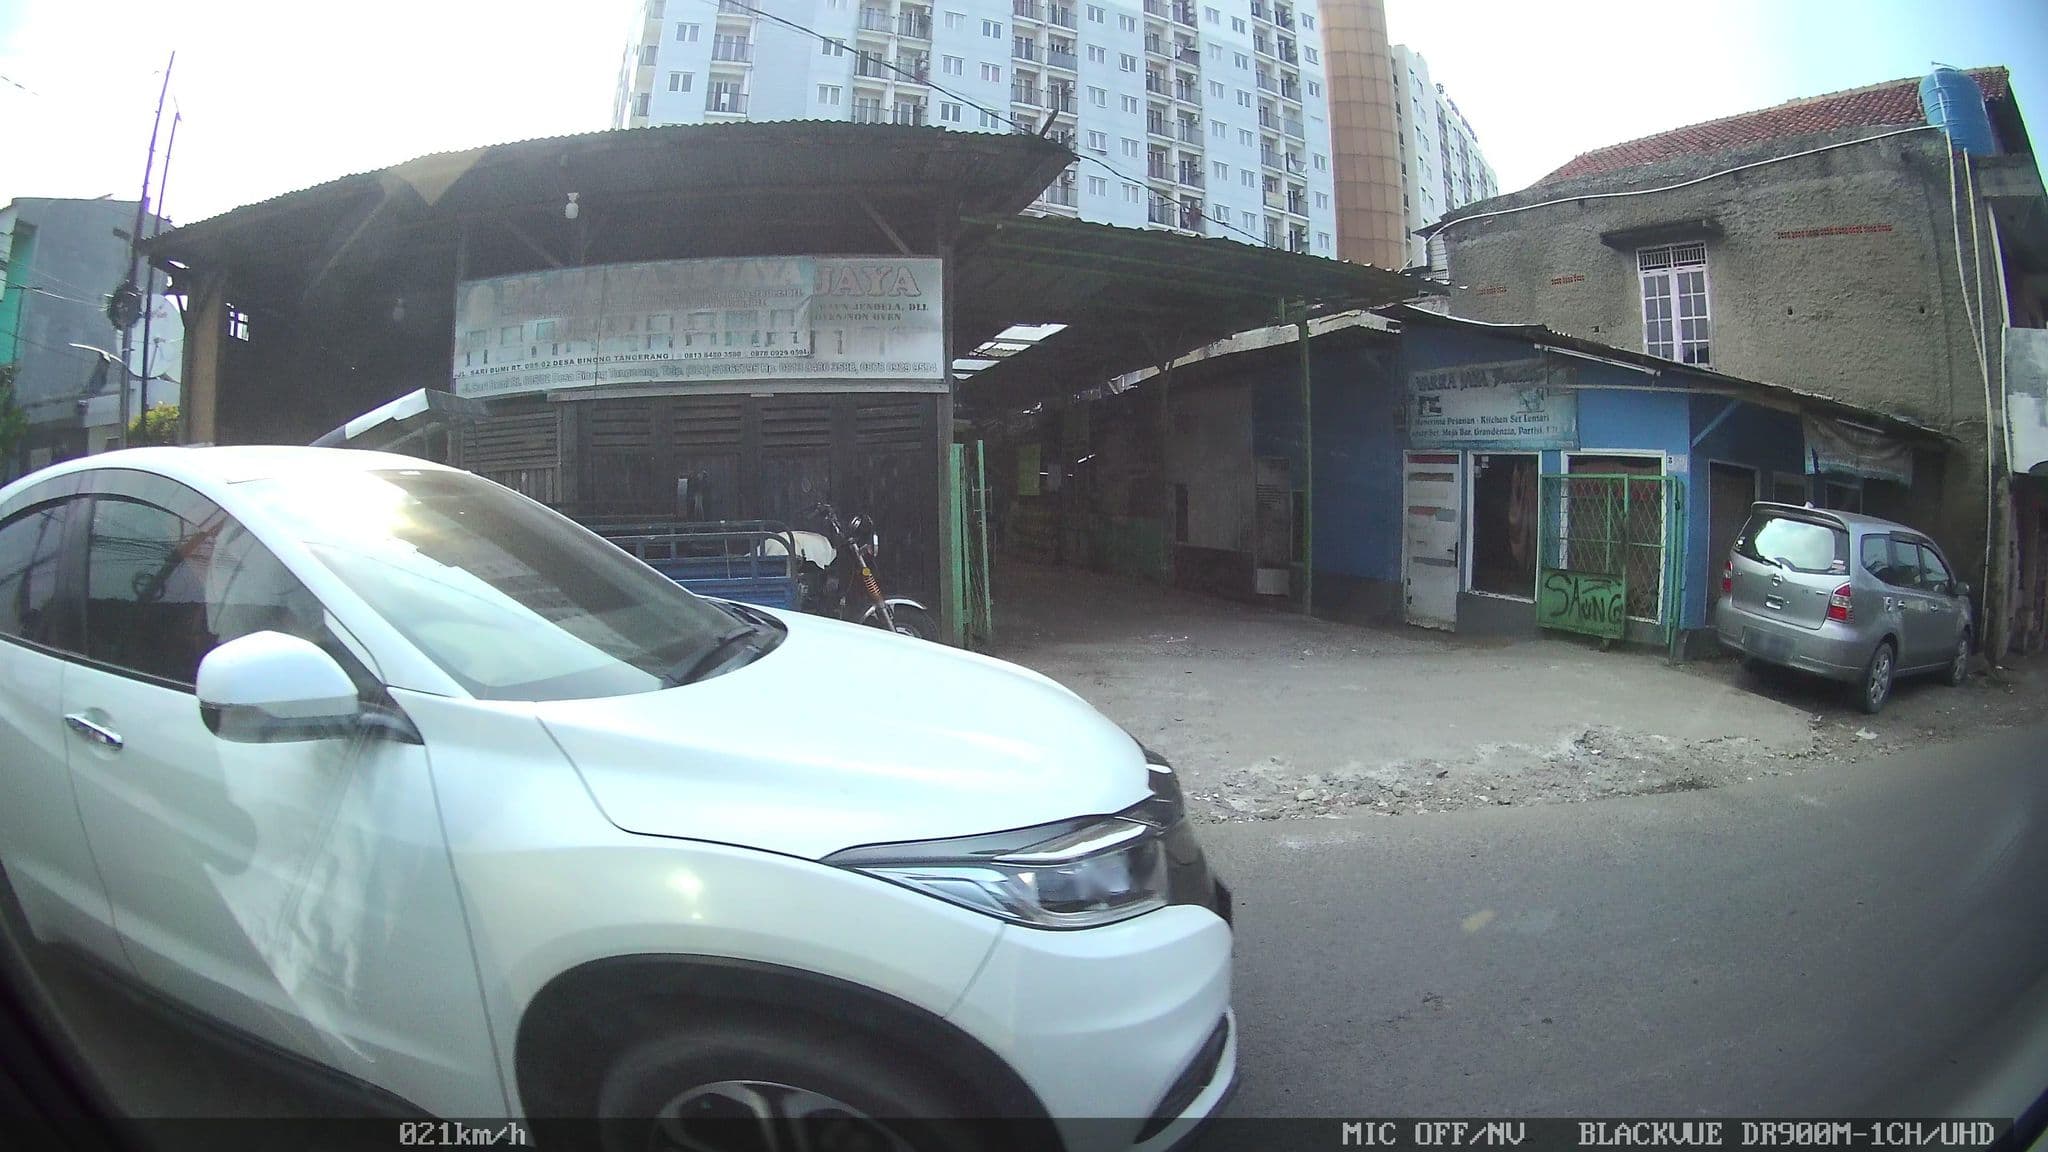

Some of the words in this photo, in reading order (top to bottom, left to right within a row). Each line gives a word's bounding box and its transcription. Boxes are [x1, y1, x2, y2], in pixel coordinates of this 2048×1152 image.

[815, 264, 922, 298] JAYA
[553, 359, 575, 367] DESA
[577, 354, 611, 365] BINONG
[615, 352, 669, 362] TANGERANG
